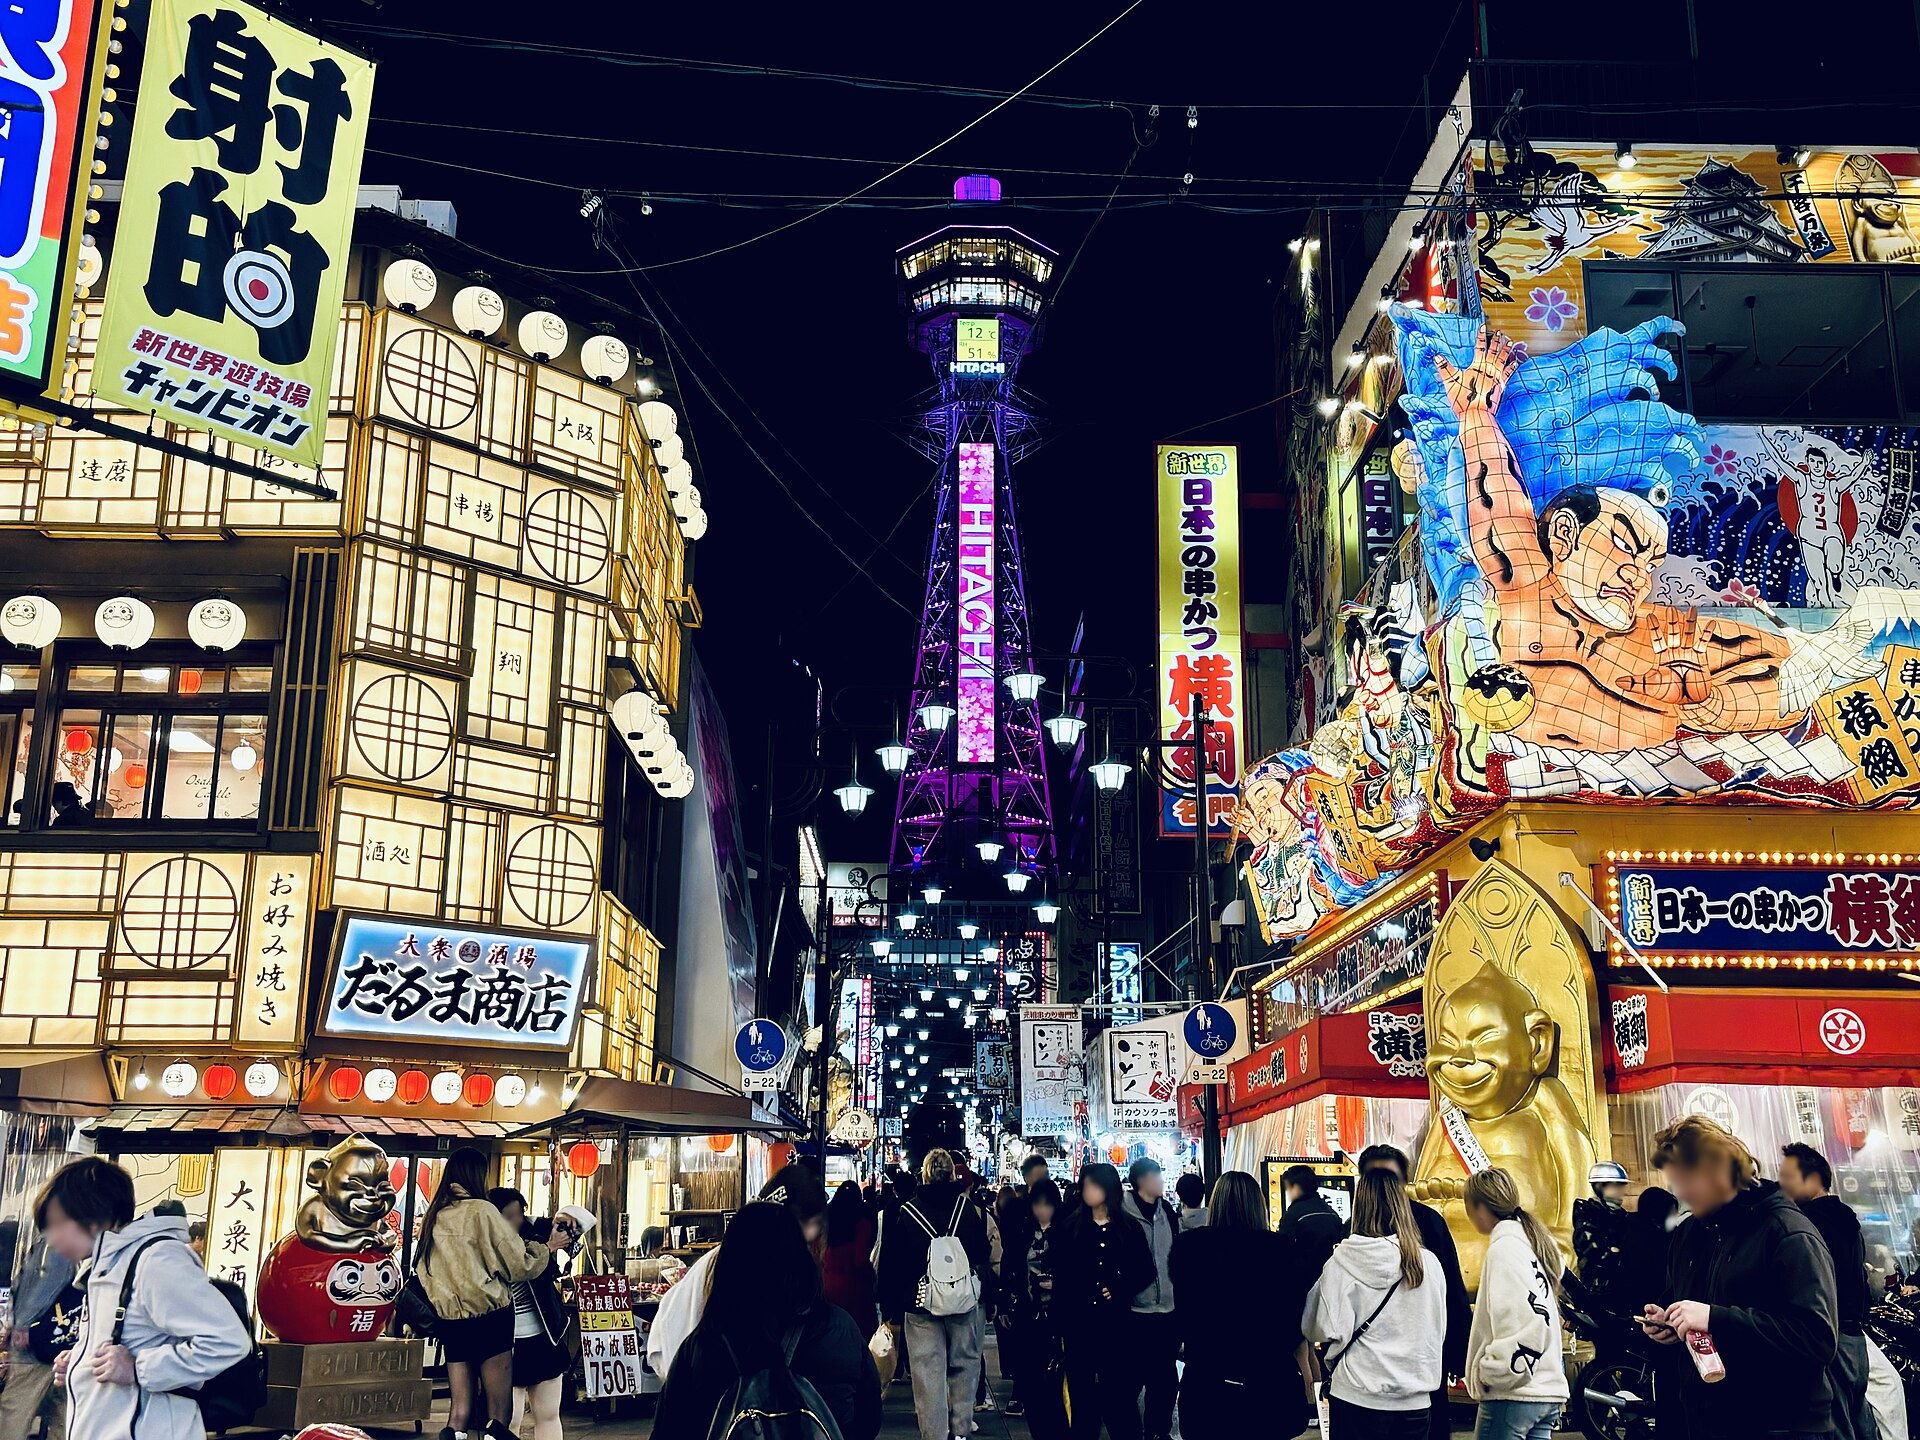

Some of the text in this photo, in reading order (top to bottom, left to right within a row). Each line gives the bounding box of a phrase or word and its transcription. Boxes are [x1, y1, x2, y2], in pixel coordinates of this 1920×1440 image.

[143, 9, 352, 365] 射的
[968, 327, 983, 339] 12
[968, 348, 983, 359] 51
[132, 328, 312, 409] 新世界遊技場
[950, 361, 1005, 374] HITACHI
[123, 361, 311, 447] チャンピオン
[557, 416, 596, 446] 大阪
[78, 458, 131, 483] 達磨
[1167, 452, 1227, 475] 新世界
[453, 493, 494, 523] 串揚
[1811, 492, 1828, 531] グリコ
[1180, 478, 1218, 650] 日本一の串かつ
[959, 502, 994, 678] HITACHI
[498, 651, 522, 675] 翔
[1169, 653, 1236, 786] 横綱
[1834, 690, 1909, 790] 横綱
[366, 838, 411, 865] 酒処
[1629, 877, 1654, 943] 新世界
[1657, 889, 1826, 933] 日本一の串かつ
[255, 872, 295, 1026] お好み焼き
[399, 933, 538, 971] 大衆 酒場
[337, 955, 572, 1034] だるま商店
[1613, 996, 1646, 1016] 日本一の串かつ
[1614, 1010, 1648, 1054] 横綱
[987, 1042, 1004, 1078] 串カツ
[744, 1077, 775, 1088] 9-22
[1193, 1069, 1226, 1080] 9-22
[1124, 1108, 1177, 1117] カウンター席
[1124, 1119, 1177, 1128] 座敷あります
[1025, 1121, 1073, 1133] 宴会予約受付
[577, 1278, 627, 1293] メニュー全部
[579, 1295, 630, 1311] 飲み放題OK
[350, 1308, 377, 1333] 福
[582, 1313, 631, 1329] 生ビール込
[583, 1334, 637, 1358] 飲み放題
